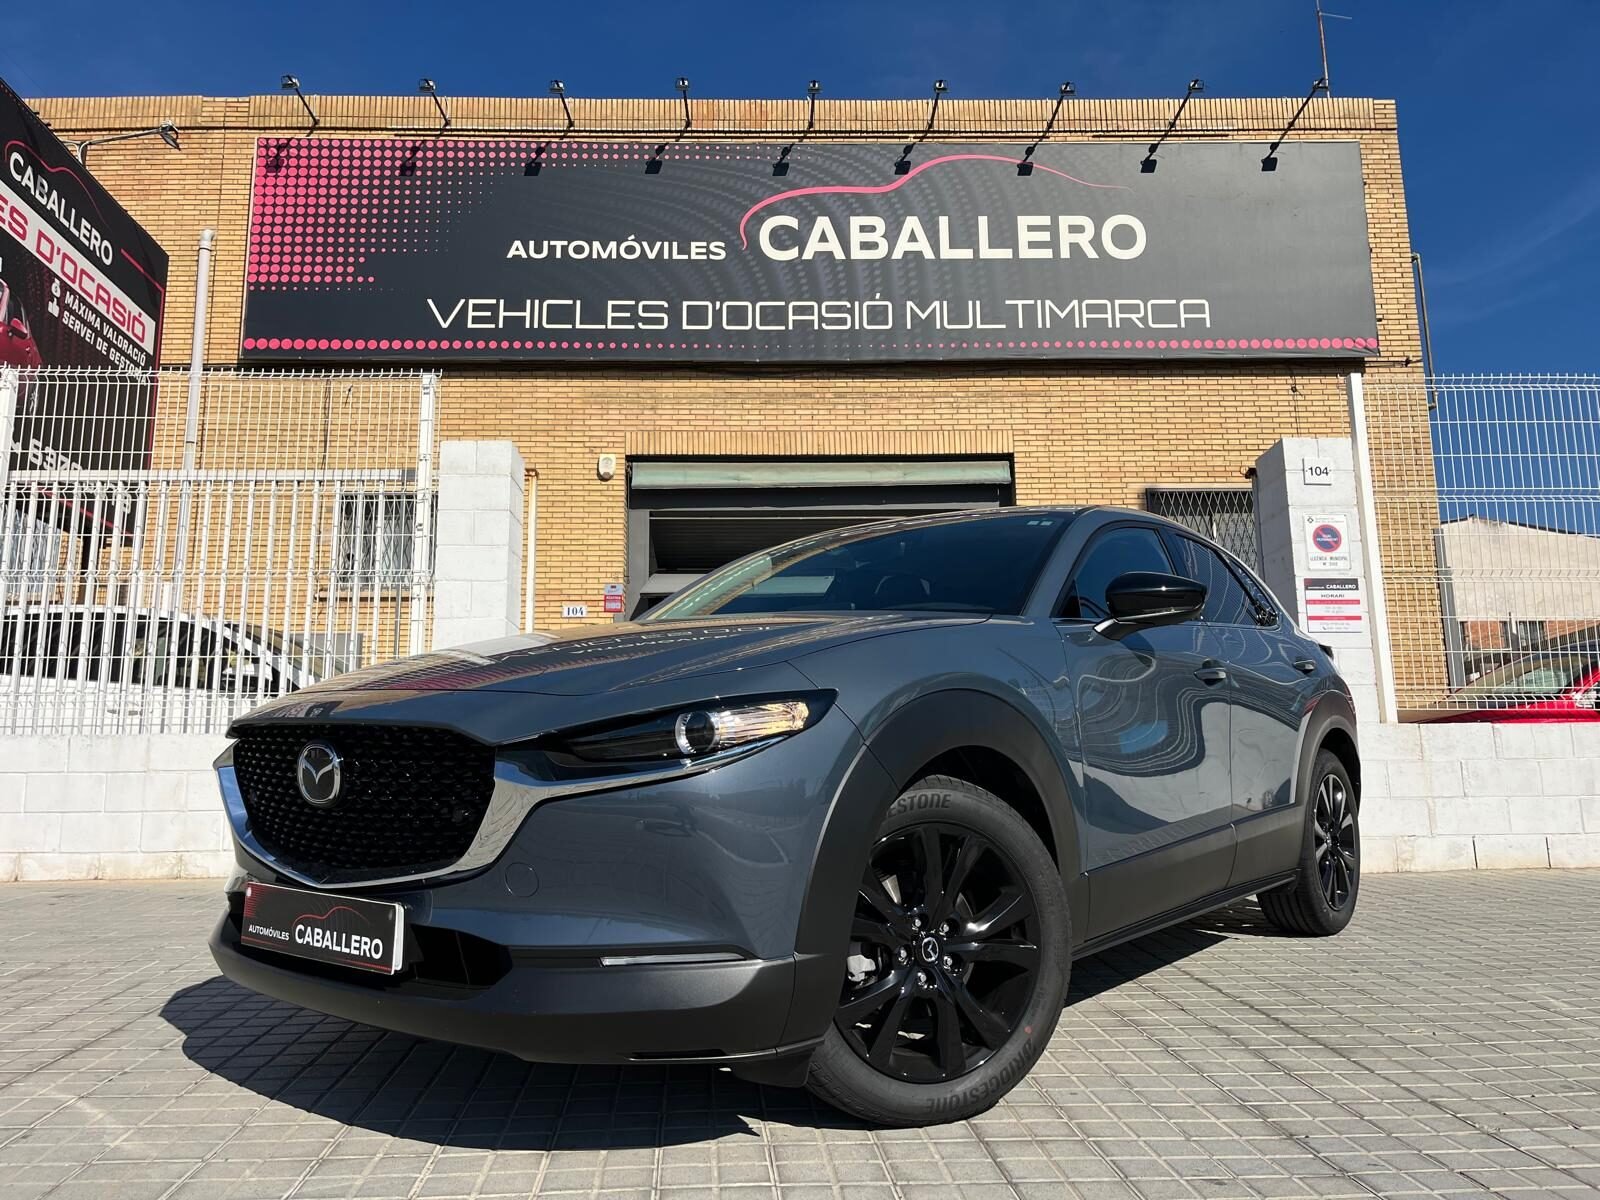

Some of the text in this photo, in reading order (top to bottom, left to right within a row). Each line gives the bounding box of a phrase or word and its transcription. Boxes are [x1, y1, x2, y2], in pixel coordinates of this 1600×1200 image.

[9, 151, 113, 266] CABALLERO
[506, 214, 1147, 260] AUTOMÓVILES CABALLERO
[36, 229, 146, 344] D'OCASIÓ
[62, 310, 95, 344] SERVEI
[96, 337, 109, 355] DE
[426, 293, 1211, 330] VEHICLES D'OCASIÓ MULTIMARCA
[103, 322, 146, 367] VALORACIÓ
[1308, 466, 1330, 476] 104
[567, 606, 584, 616] 104
[248, 924, 383, 960] AUTOMÓVILES CABALLERO
